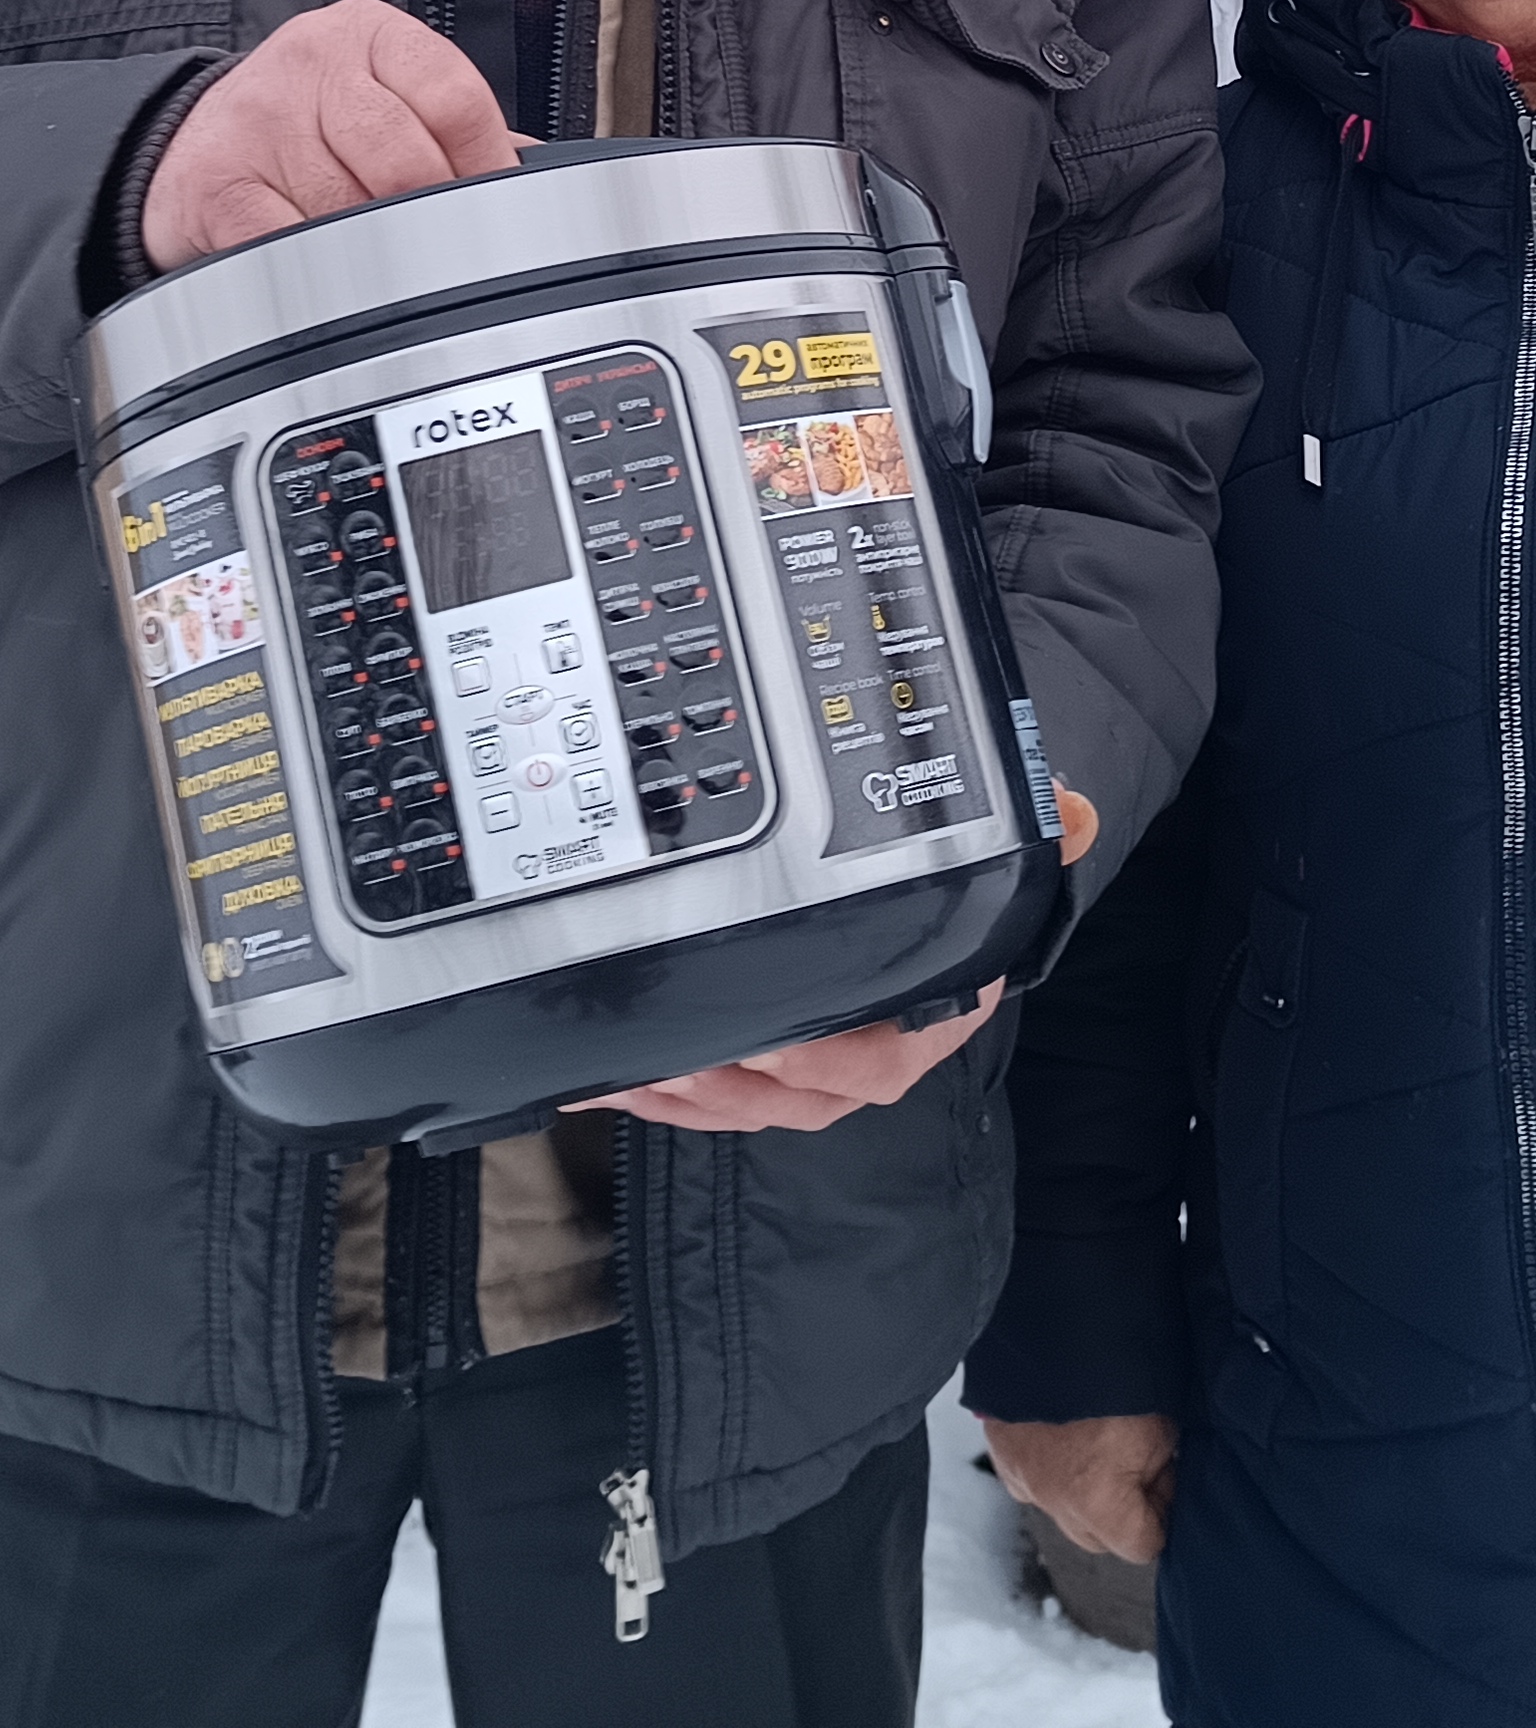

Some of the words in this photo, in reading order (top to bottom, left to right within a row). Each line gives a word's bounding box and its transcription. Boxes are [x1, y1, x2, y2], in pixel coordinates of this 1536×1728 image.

[729, 340, 796, 387] 29
[810, 353, 873, 373] програм
[413, 402, 518, 448] rotex
[778, 529, 835, 551] POWER
[799, 601, 842, 616] Volume
[819, 680, 857, 696] Recipe
[857, 674, 884, 688] book
[887, 668, 913, 681] Time
[895, 754, 958, 786] SMART
[547, 852, 605, 874] COOKING
